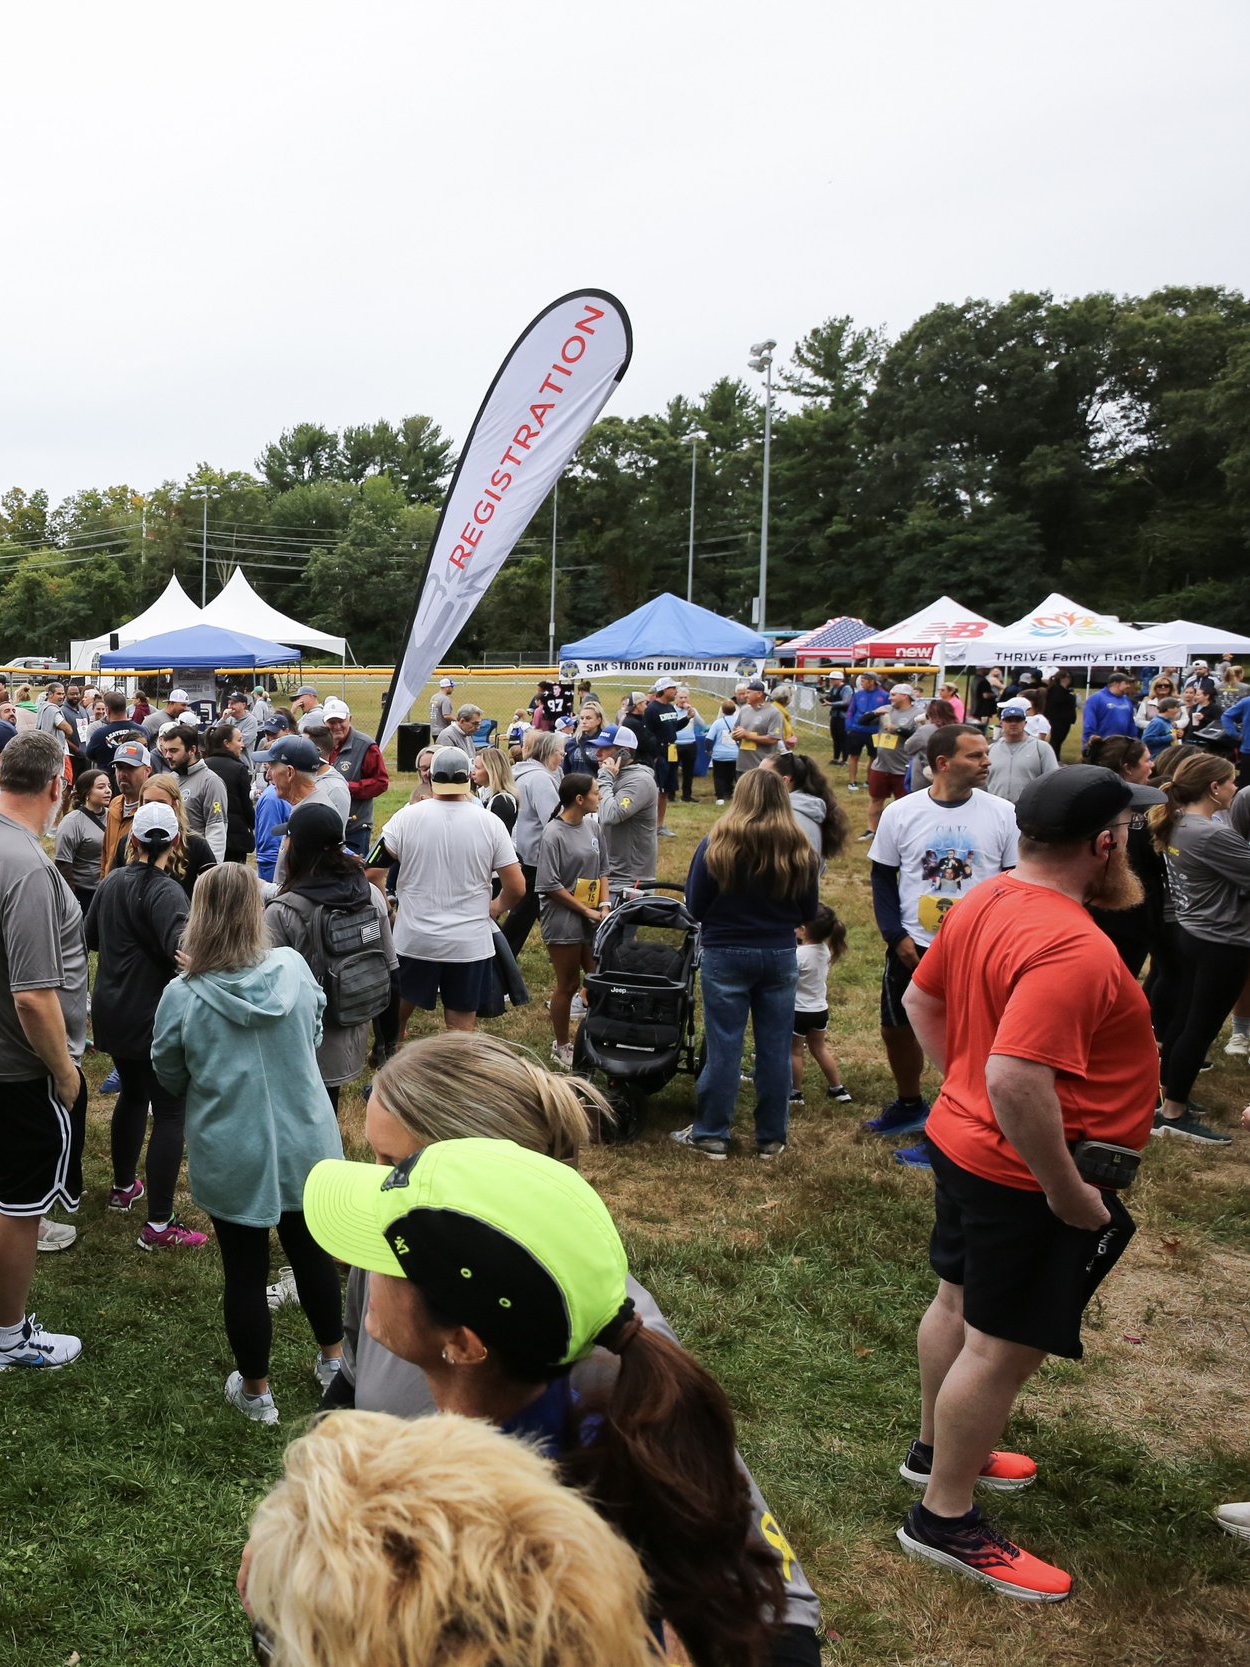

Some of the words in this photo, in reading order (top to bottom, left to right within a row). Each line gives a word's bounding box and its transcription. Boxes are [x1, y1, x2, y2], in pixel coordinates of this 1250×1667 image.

[449, 305, 605, 570] REGISTRATION
[895, 647, 932, 658] new
[995, 652, 1048, 662] THRIVE
[1053, 653, 1098, 664] Family
[1104, 652, 1156, 662] Fitness
[586, 662, 609, 673] SAK
[611, 661, 655, 672] STRONG
[657, 661, 730, 673] FOUNDATION
[547, 699, 564, 713] 97
[587, 893, 595, 903] 15
[610, 987, 627, 995] Jeep
